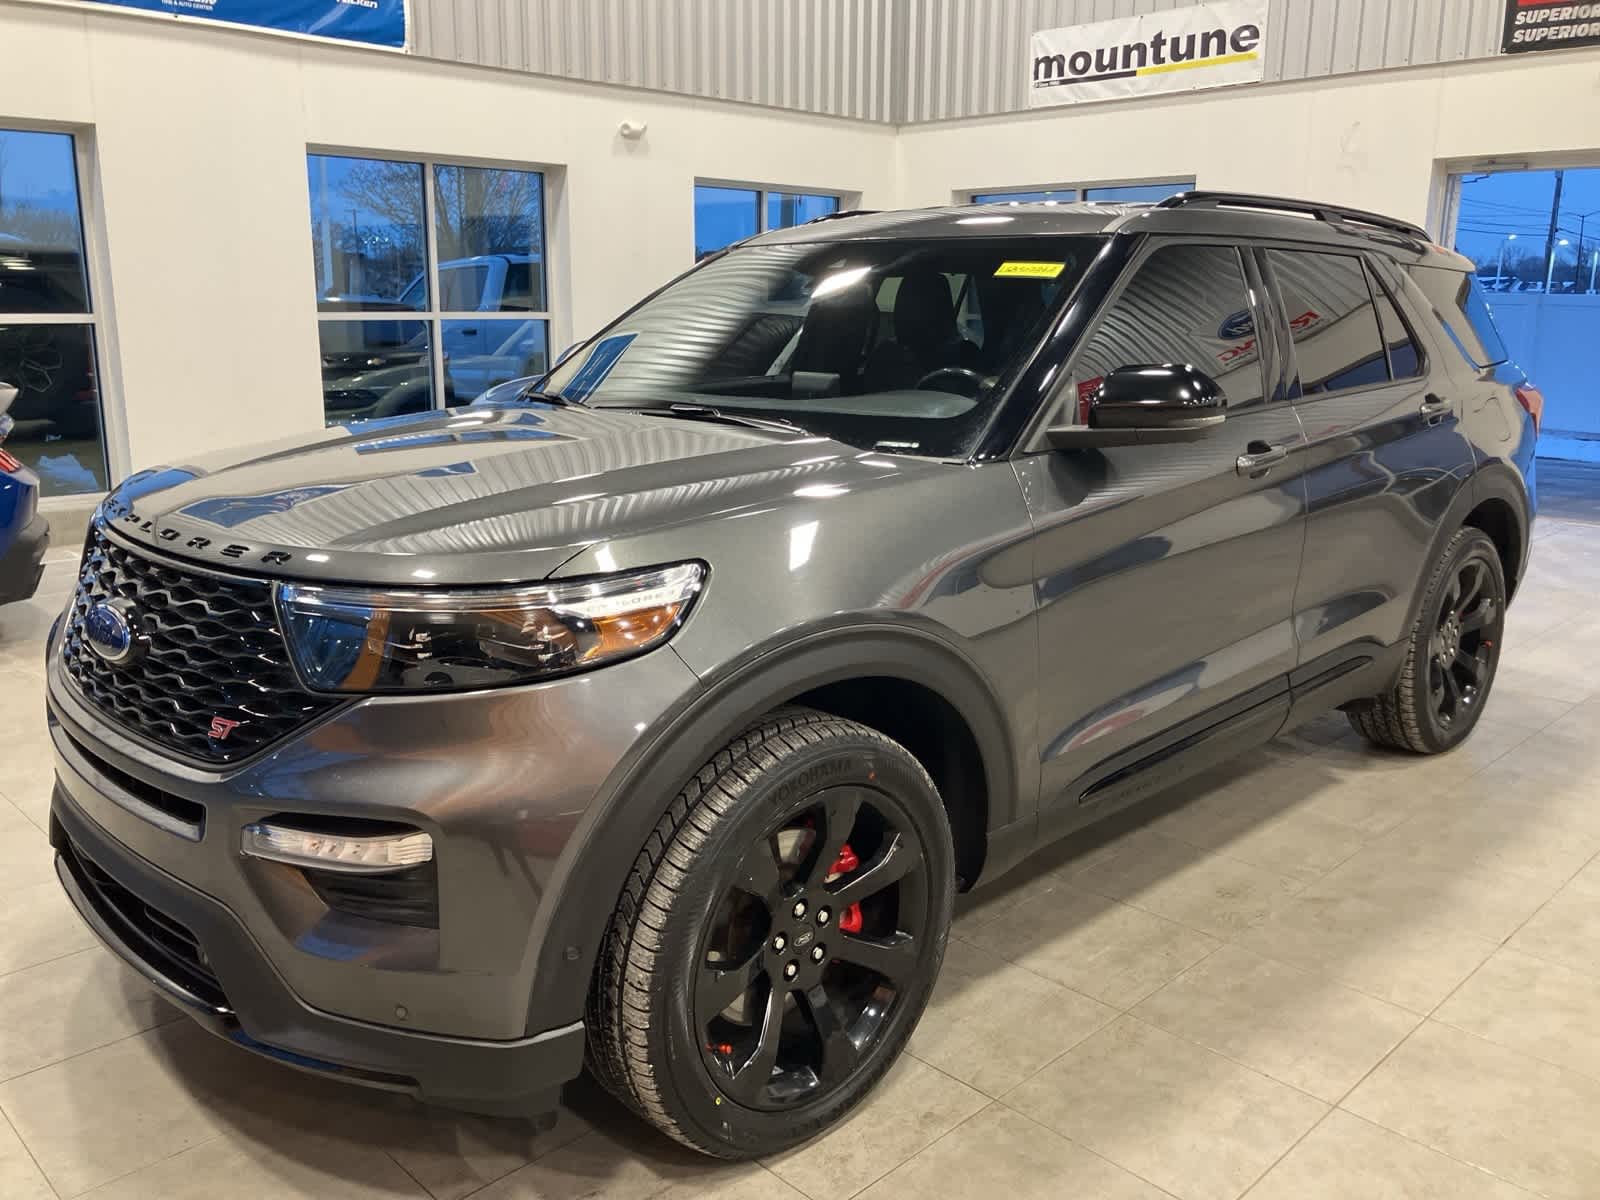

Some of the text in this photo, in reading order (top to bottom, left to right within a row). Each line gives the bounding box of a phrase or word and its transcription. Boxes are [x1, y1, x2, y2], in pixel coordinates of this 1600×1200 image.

[1515, 4, 1600, 25] SUPERIOR
[1512, 22, 1600, 43] SUPERIOR
[1033, 23, 1260, 81] mountune
[208, 716, 240, 740] ST
